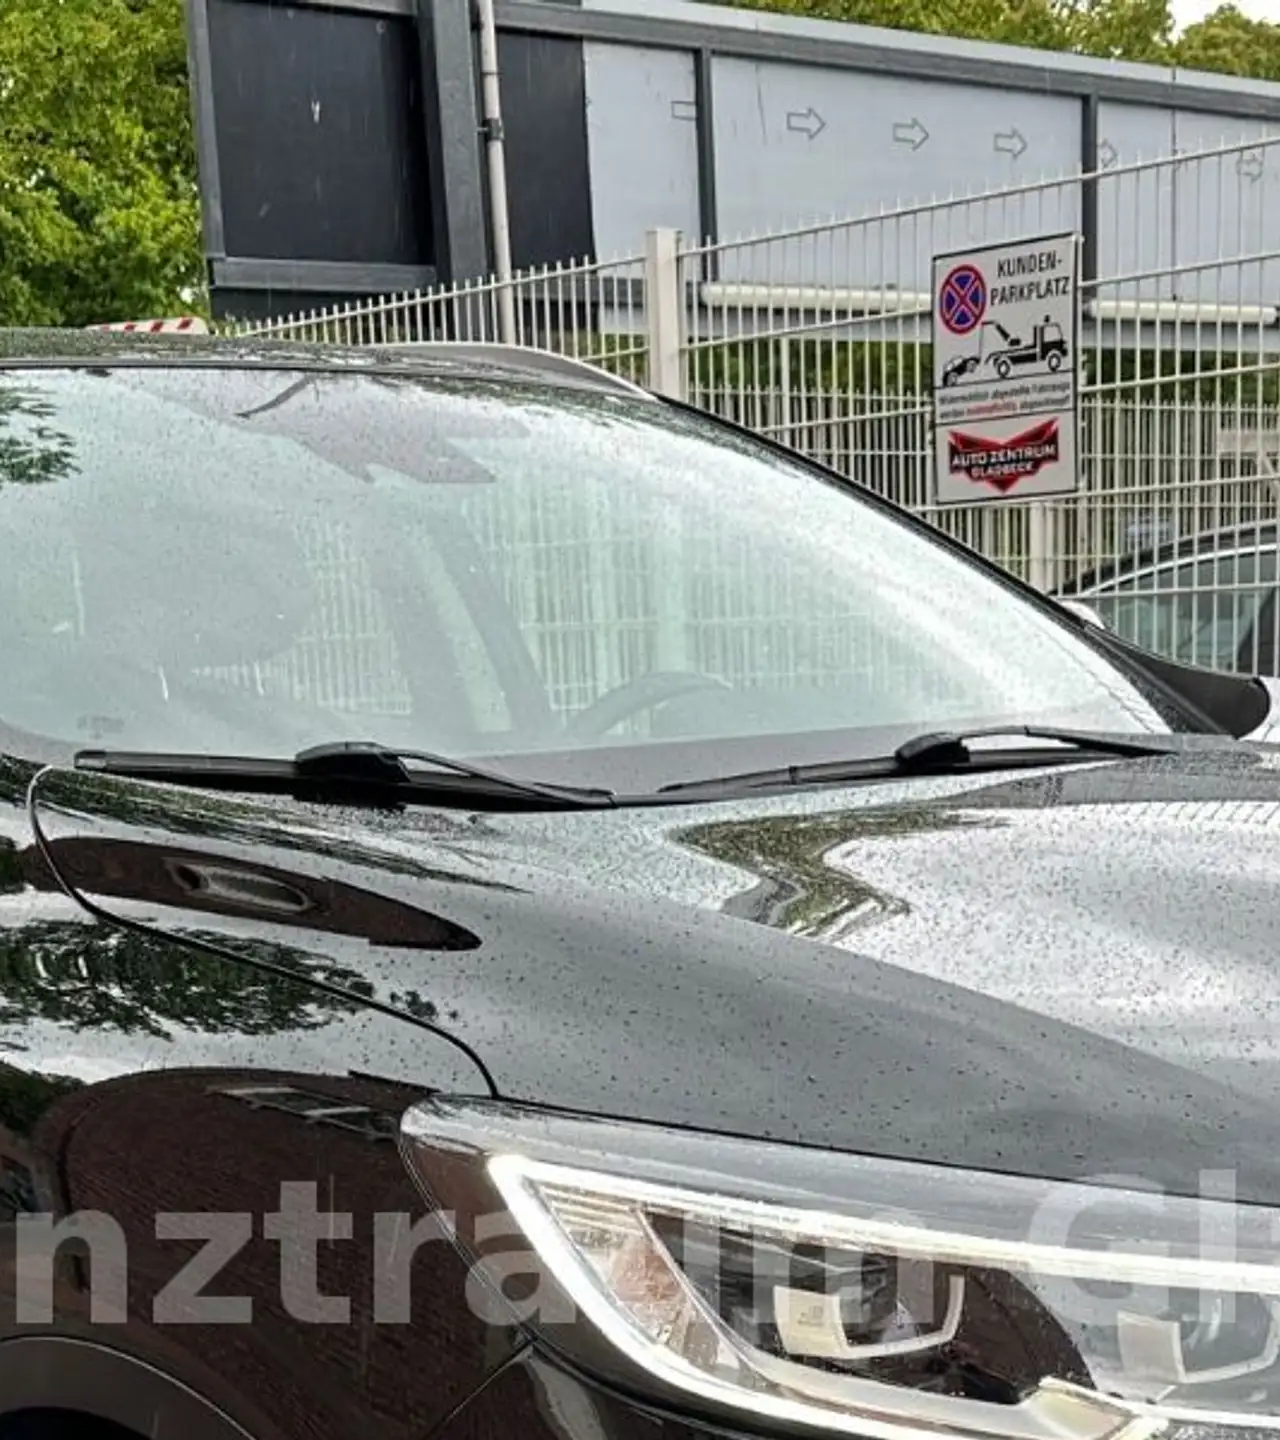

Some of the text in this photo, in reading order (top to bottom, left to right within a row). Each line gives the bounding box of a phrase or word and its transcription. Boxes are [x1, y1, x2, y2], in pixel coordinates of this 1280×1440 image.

[997, 250, 1062, 278] KUNDEN-
[990, 276, 1070, 306] PARKPLATZ
[952, 443, 1057, 467] AUTO ZENTRUM
